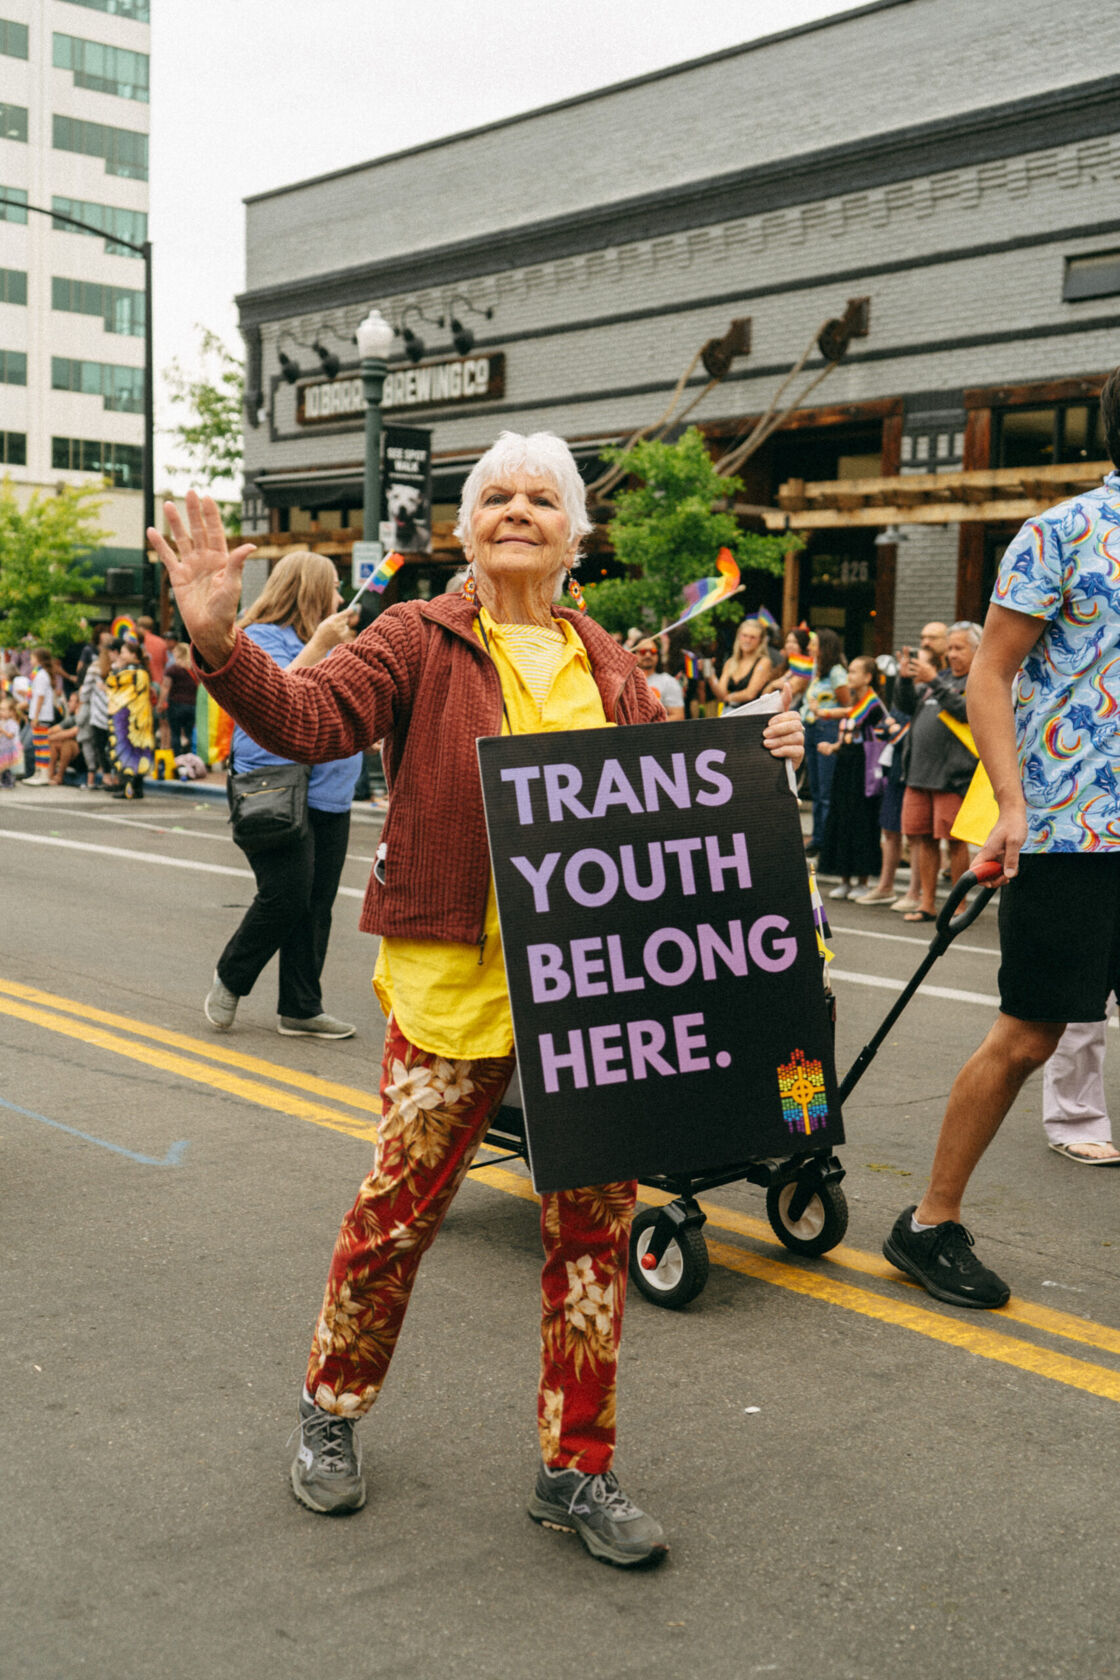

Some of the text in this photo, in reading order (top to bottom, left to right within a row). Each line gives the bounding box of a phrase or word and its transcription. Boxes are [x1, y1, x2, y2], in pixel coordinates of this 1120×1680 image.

[382, 362, 462, 407] BREWING
[500, 749, 733, 825] TRANS
[510, 832, 752, 913] YOUTH
[526, 914, 798, 1004] BELONG
[538, 1012, 732, 1094] HERE.
